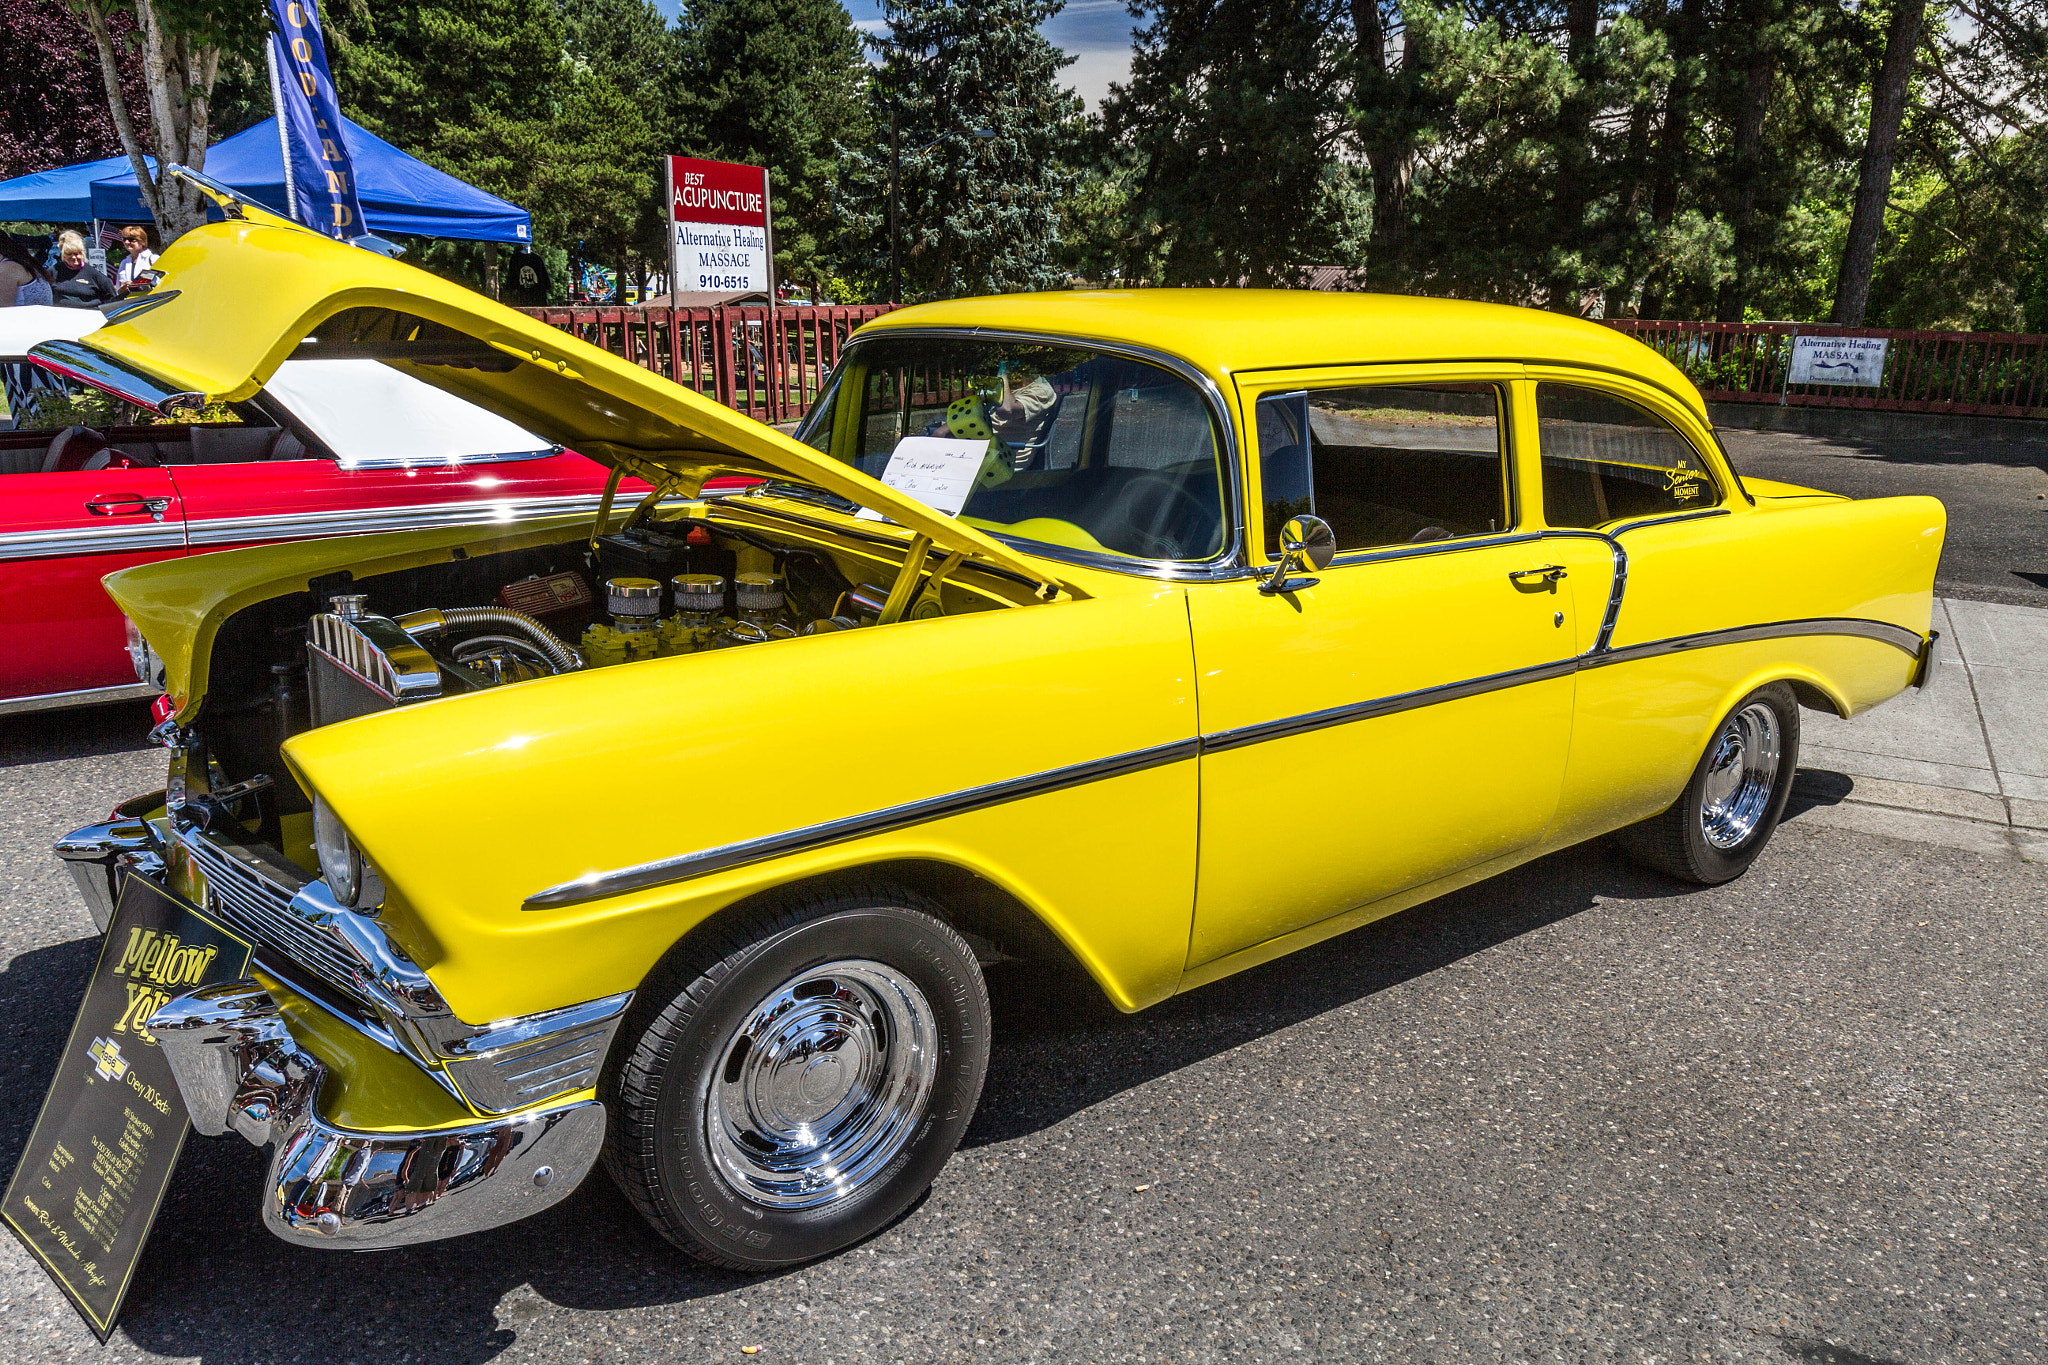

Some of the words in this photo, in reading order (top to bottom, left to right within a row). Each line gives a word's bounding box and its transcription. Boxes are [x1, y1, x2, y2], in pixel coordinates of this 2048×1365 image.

[685, 173, 704, 185] BEST
[674, 186, 762, 212] ACUPUNCTURE
[676, 226, 731, 246] Alternative
[734, 229, 764, 251] Healing
[699, 253, 750, 267] MASSAGE
[700, 275, 748, 289] 910-6515
[1800, 338, 1846, 348] Alternative
[1849, 340, 1881, 350] Healing
[1678, 460, 1686, 468] MY
[1663, 468, 1700, 491] Senior
[1674, 487, 1699, 496] MOMENT
[113, 924, 218, 987] Mellow
[101, 1050, 116, 1068] 1956
[126, 1071, 146, 1097] Chevy
[153, 1093, 171, 1117] Sedan
